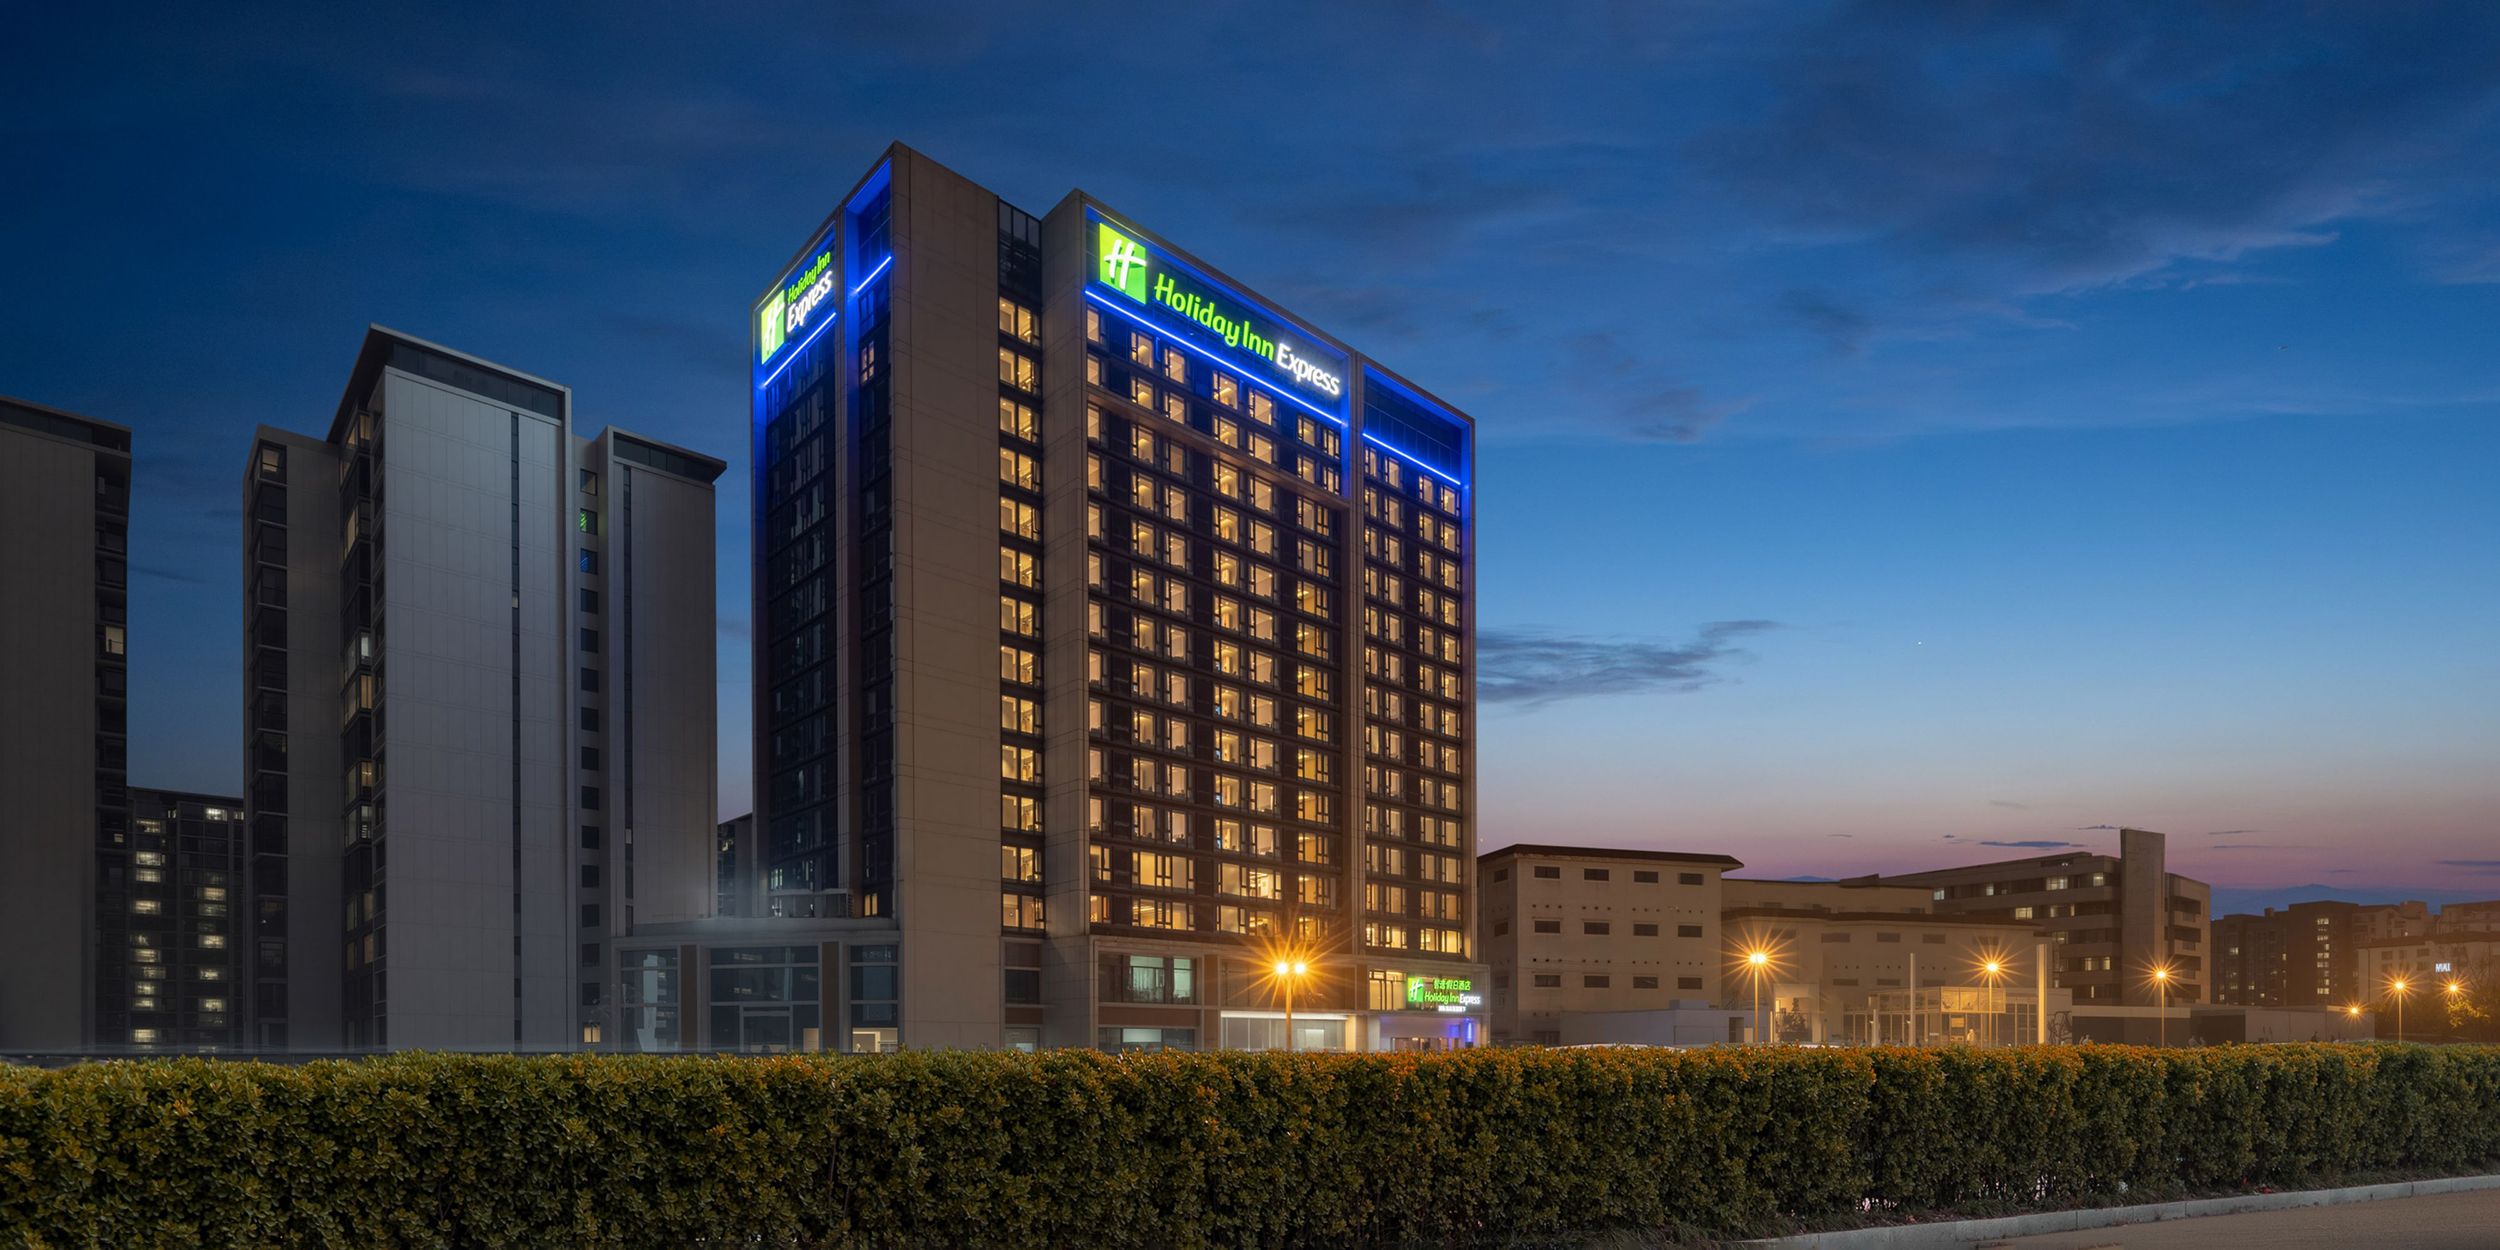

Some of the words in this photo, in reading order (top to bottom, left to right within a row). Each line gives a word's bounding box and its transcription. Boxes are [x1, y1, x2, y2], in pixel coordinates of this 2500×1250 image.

[786, 271, 833, 333] Express
[787, 265, 817, 305] Holiday
[817, 251, 831, 275] Inn
[1154, 273, 1240, 348] Holiday
[1243, 320, 1275, 362] Inn
[1276, 342, 1341, 396] Express
[1424, 991, 1449, 1005] Holiday
[1450, 992, 1460, 1003] Inn
[1459, 993, 1481, 1006] Express
